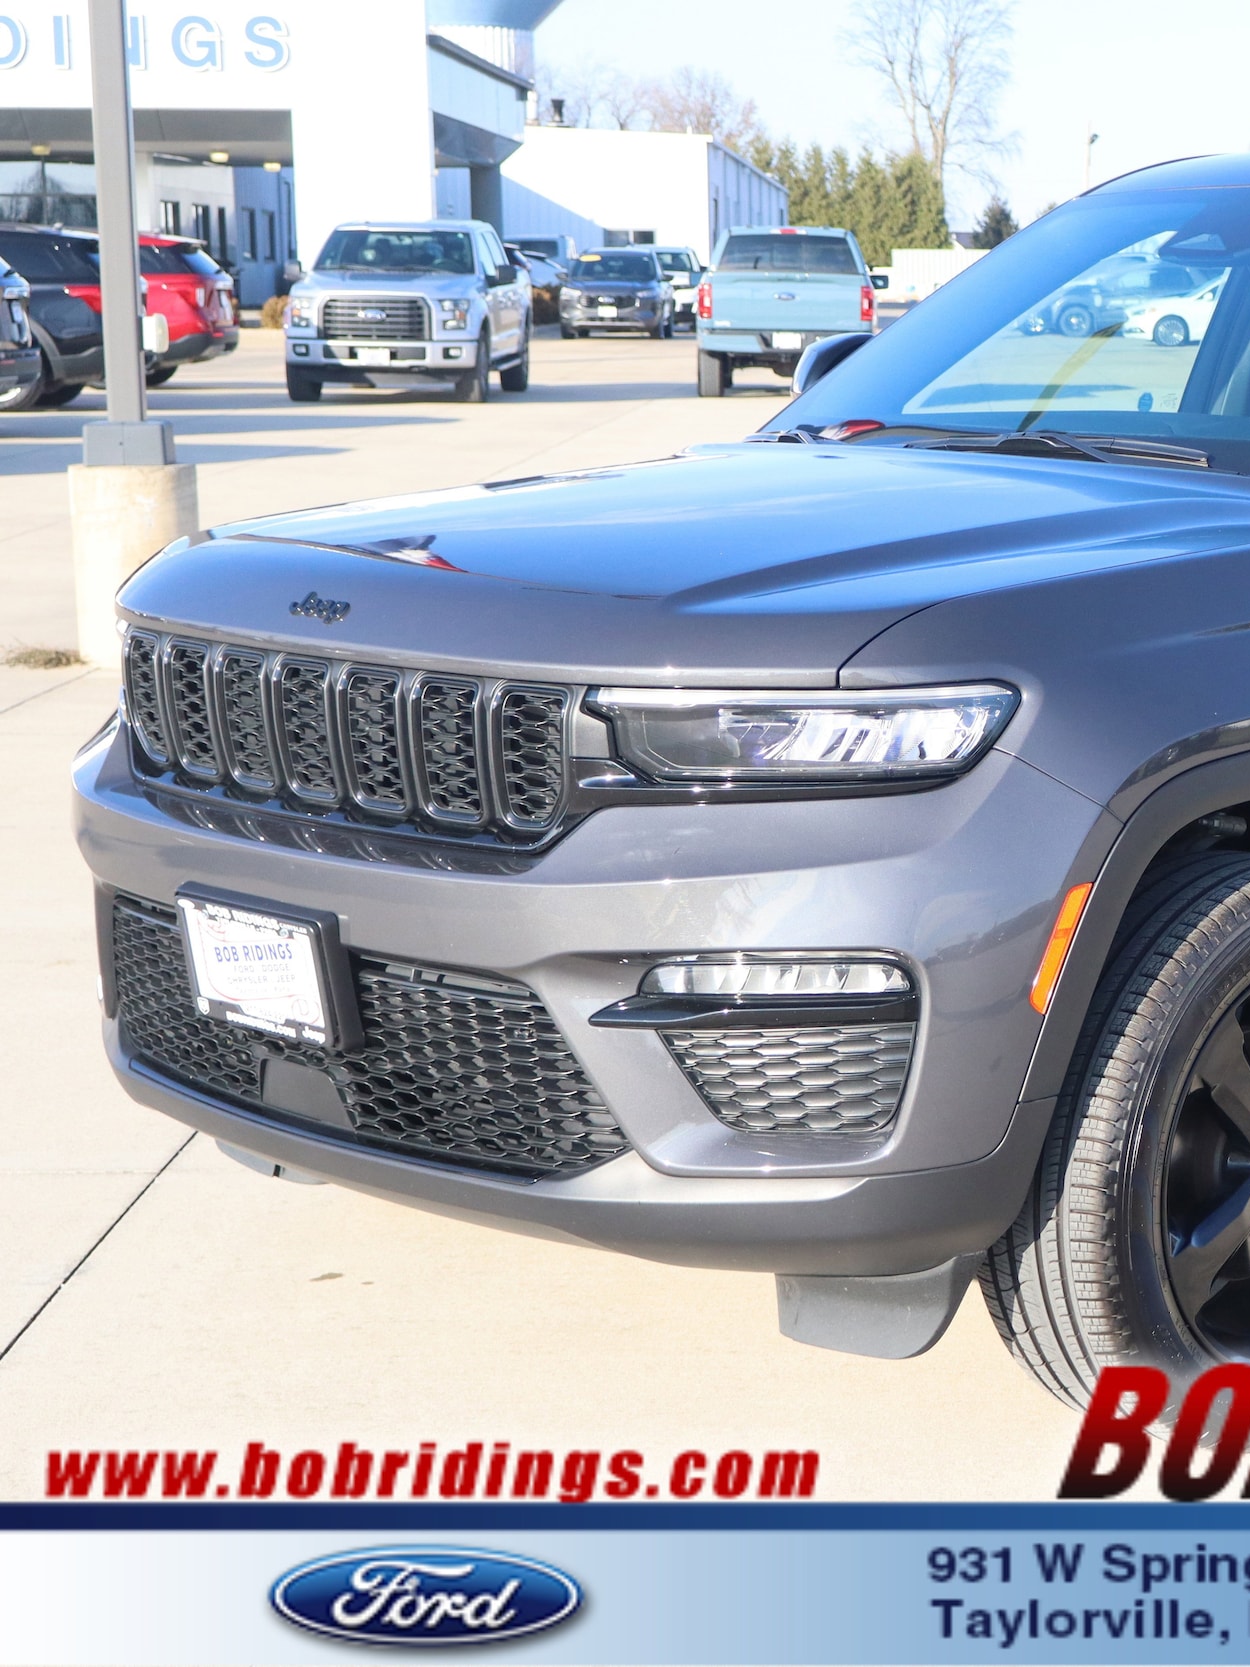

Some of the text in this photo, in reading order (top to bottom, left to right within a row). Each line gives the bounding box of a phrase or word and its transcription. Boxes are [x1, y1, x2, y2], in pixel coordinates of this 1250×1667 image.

[289, 591, 351, 624] Jeep
[214, 943, 293, 962] BOB RIDINGS
